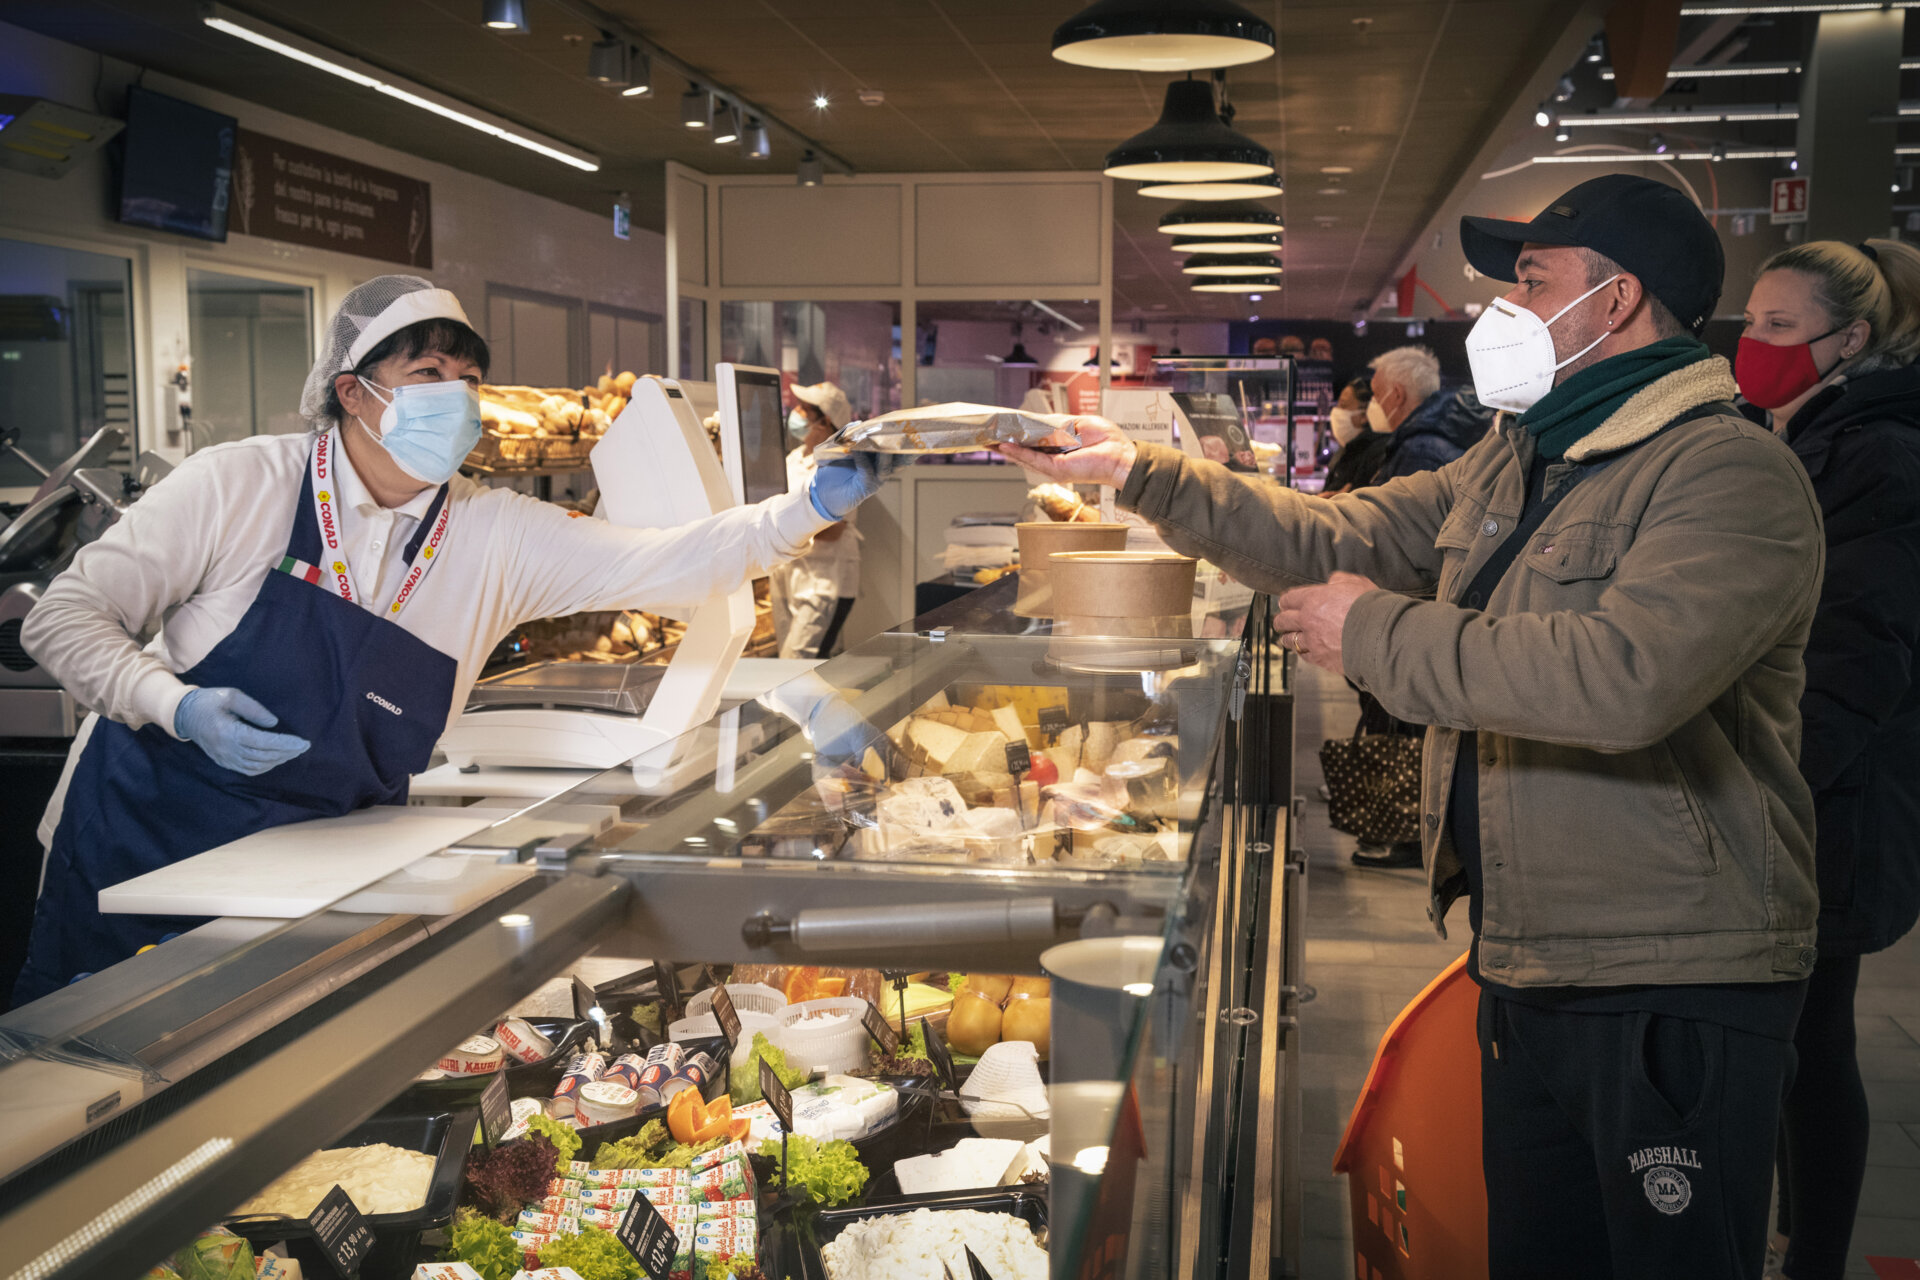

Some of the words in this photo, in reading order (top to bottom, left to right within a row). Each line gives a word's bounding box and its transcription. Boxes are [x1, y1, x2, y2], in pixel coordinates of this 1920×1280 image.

[317, 434, 329, 480] CONAD
[320, 502, 338, 550] CONAD
[430, 509, 448, 548] CONAD
[338, 574, 352, 601] CON
[397, 566, 422, 604] CONAD
[373, 695, 402, 716] CONAD
[464, 1060, 497, 1074] MAURI
[1627, 1146, 1703, 1174] MARSHALL
[1656, 1183, 1680, 1196] MA
[337, 1252, 347, 1266] €
[650, 1261, 661, 1274] €
